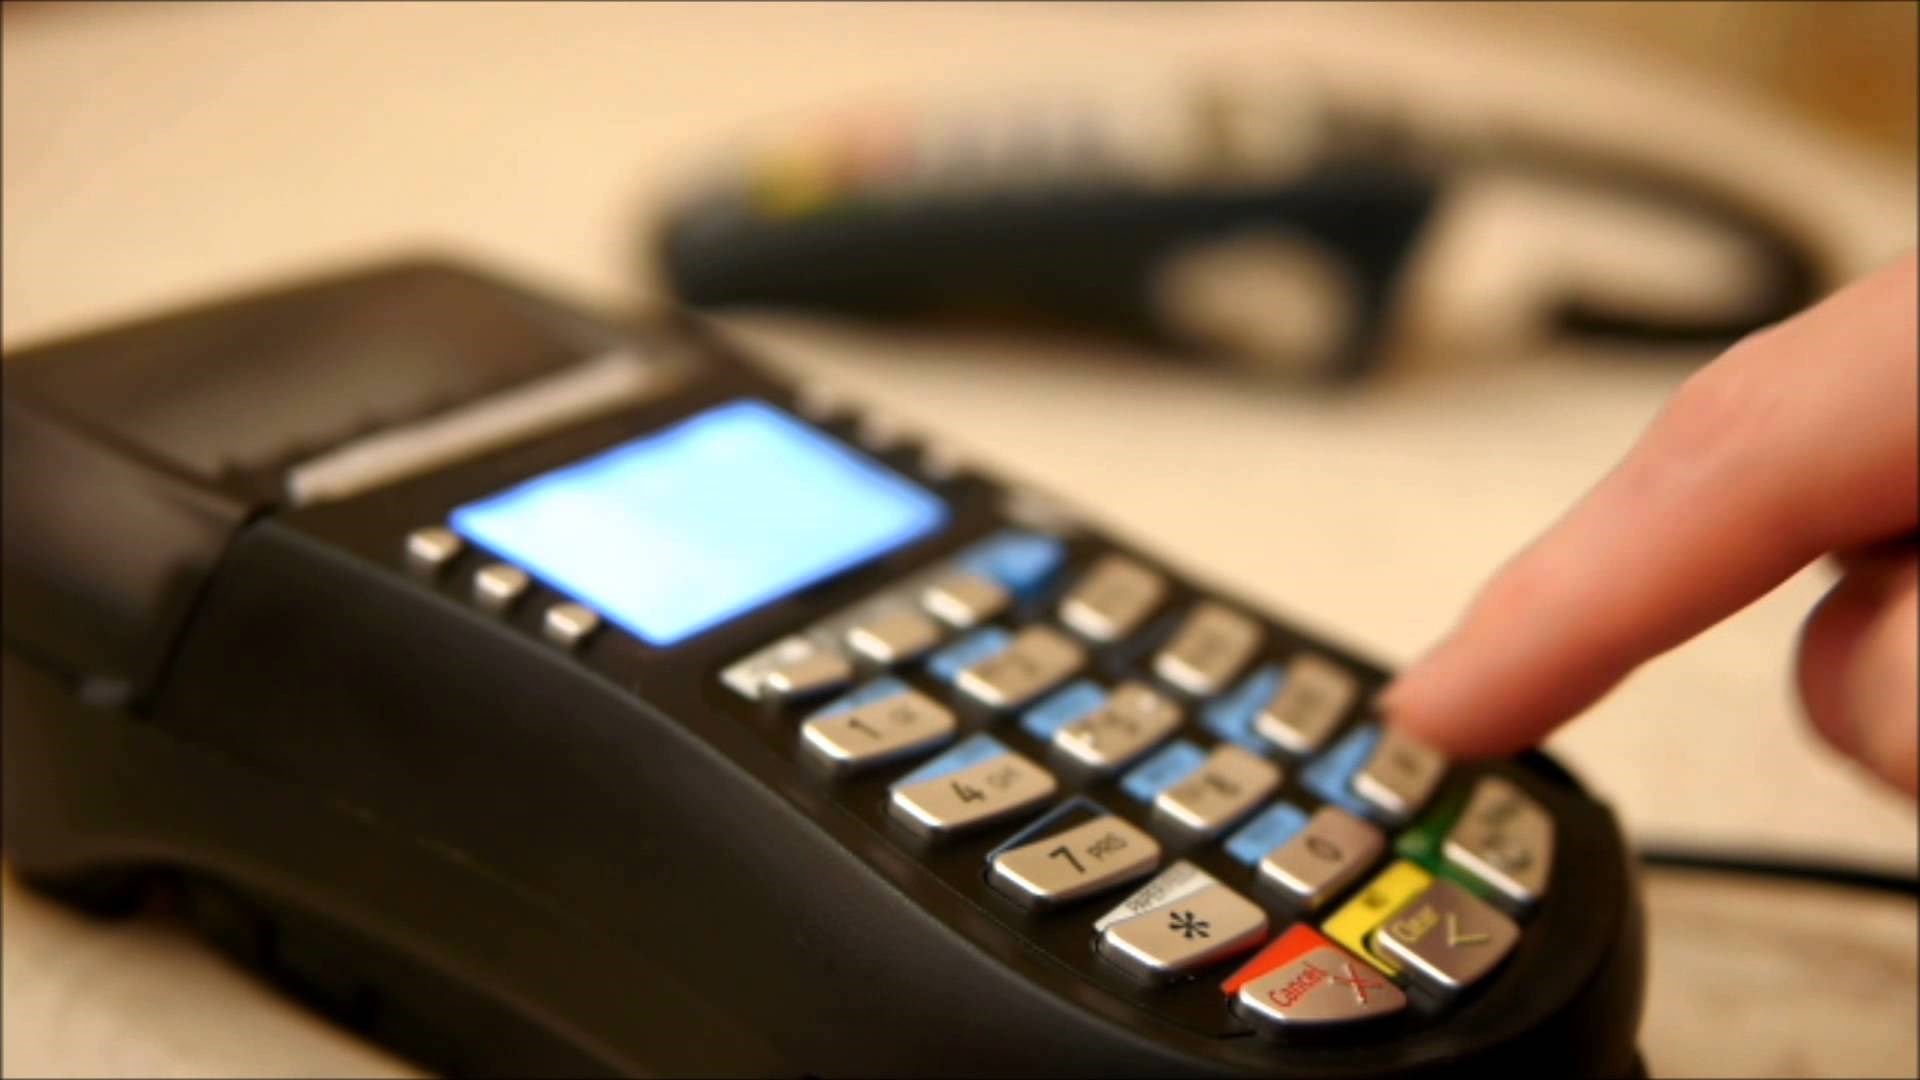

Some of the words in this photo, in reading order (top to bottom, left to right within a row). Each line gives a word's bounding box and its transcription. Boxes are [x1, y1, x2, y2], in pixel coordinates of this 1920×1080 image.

[848, 717, 882, 740] 1
[951, 781, 985, 804] 4
[1048, 845, 1086, 874] 7
[1268, 961, 1329, 1008] Cancel
